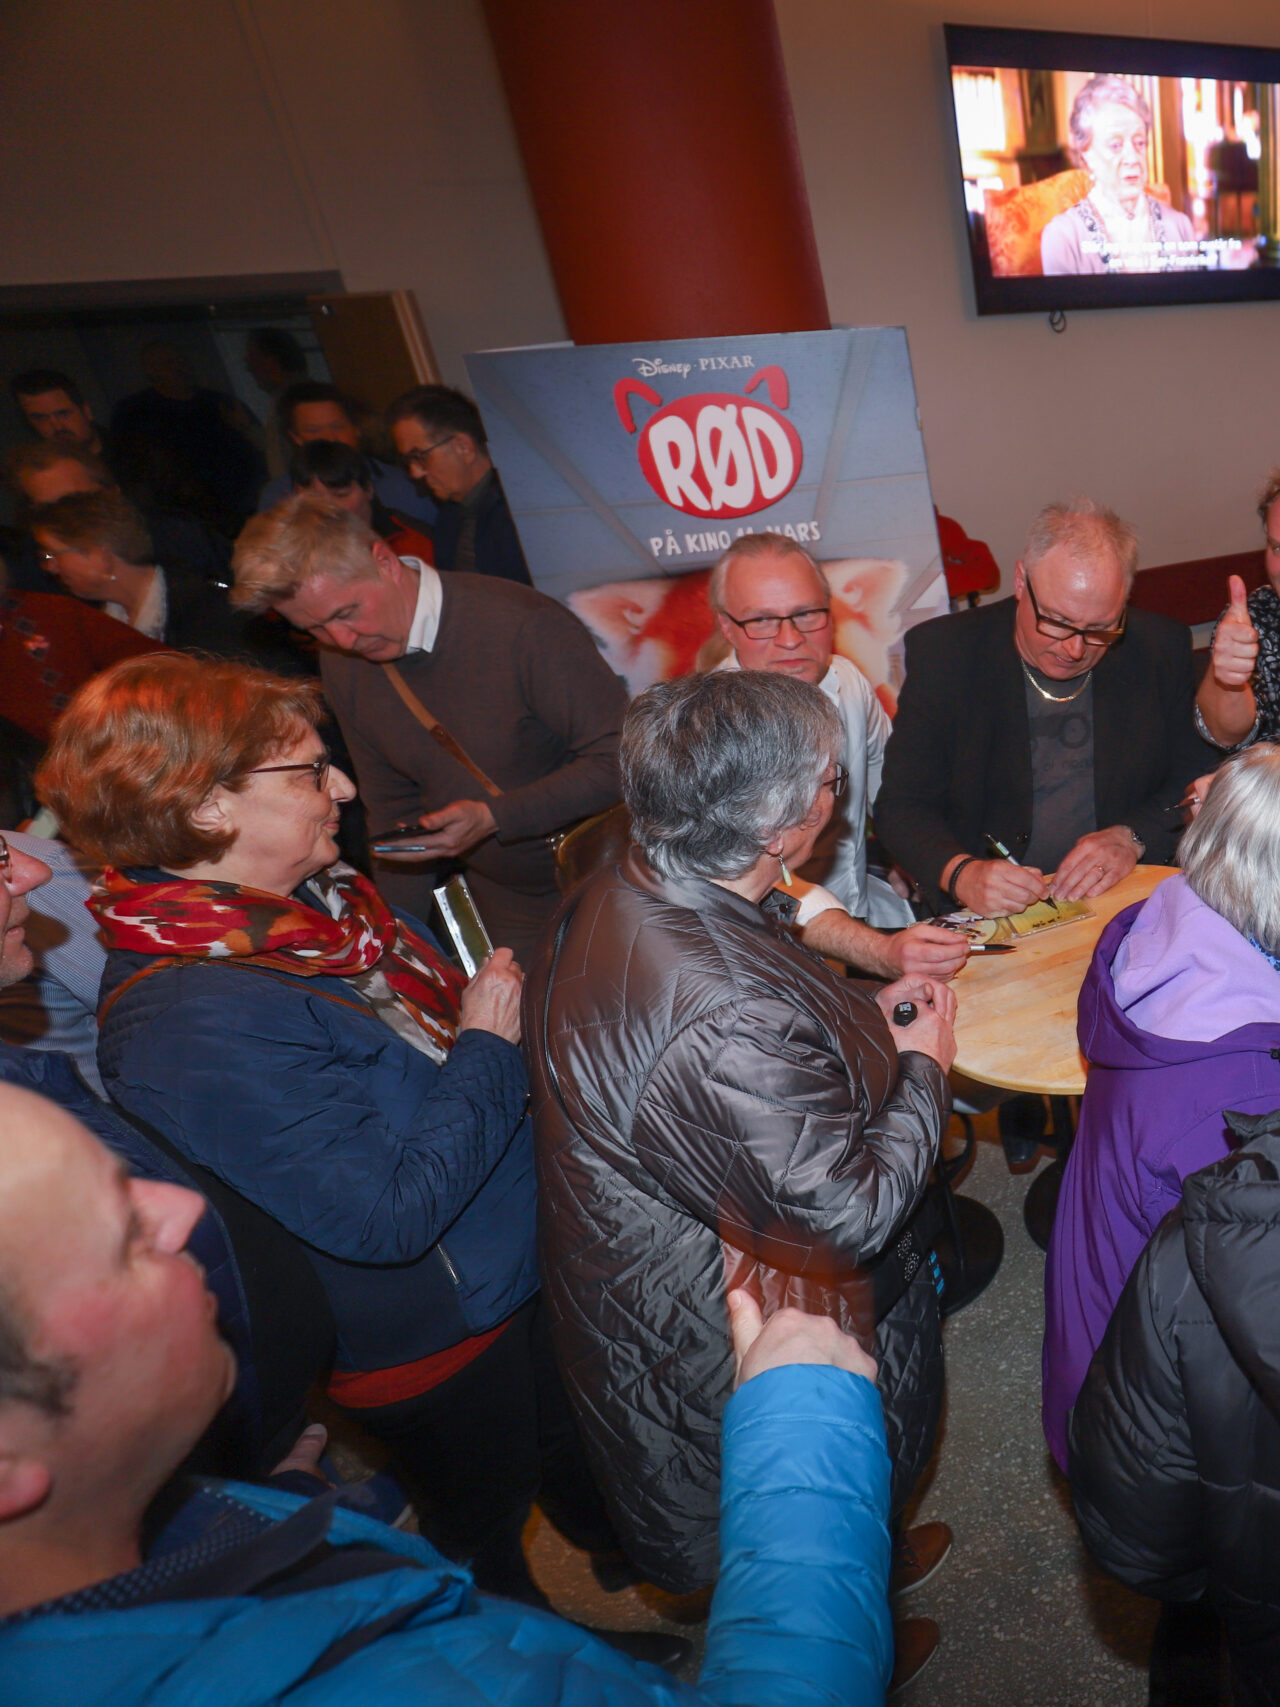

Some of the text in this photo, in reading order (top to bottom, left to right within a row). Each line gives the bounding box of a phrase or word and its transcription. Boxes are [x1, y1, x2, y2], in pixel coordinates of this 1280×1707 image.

[632, 355, 755, 379] Disney PIXAR
[648, 404, 795, 511] RØD
[649, 528, 682, 556] PÅ
[684, 530, 731, 553] KINO
